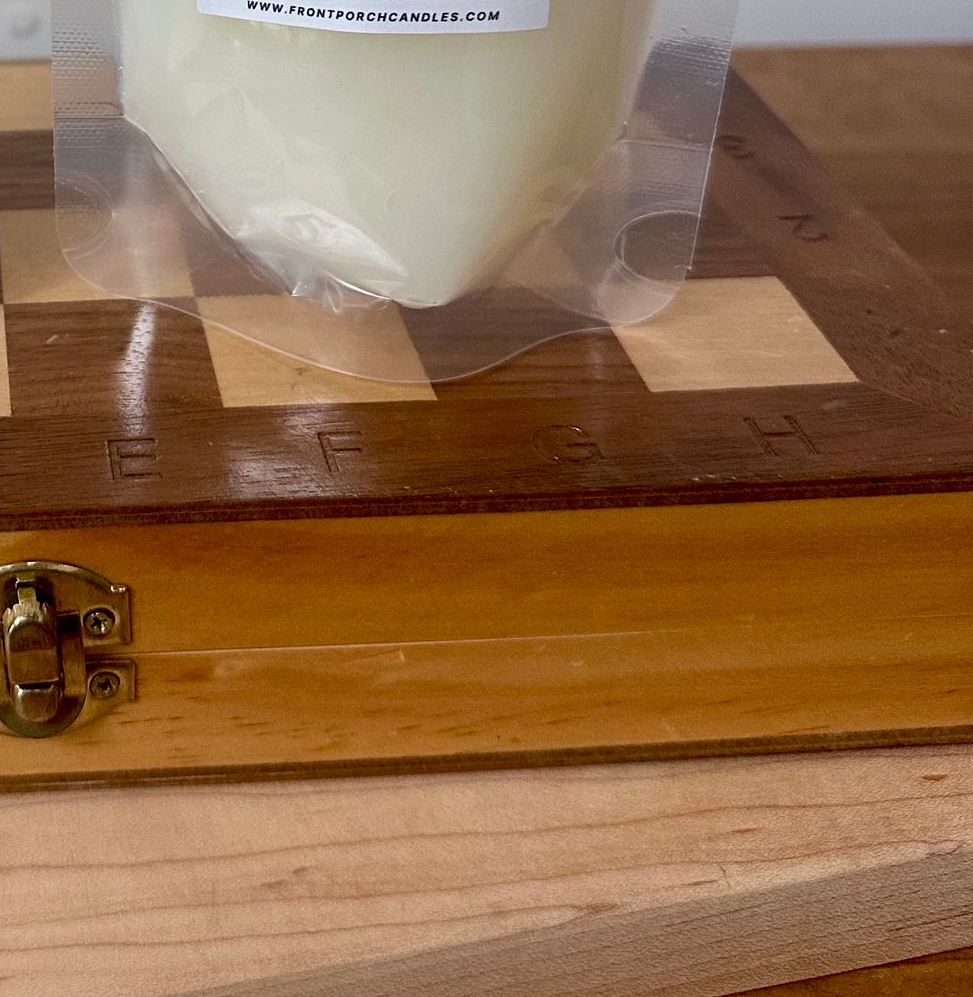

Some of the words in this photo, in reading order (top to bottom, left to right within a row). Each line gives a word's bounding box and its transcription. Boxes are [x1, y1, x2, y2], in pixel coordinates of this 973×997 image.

[247, 0, 500, 22] WWW.FRONTPORCHCANDLES.COM
[106, 437, 162, 482] E
[317, 429, 363, 474] F
[532, 424, 605, 464] G
[743, 414, 820, 457] H
